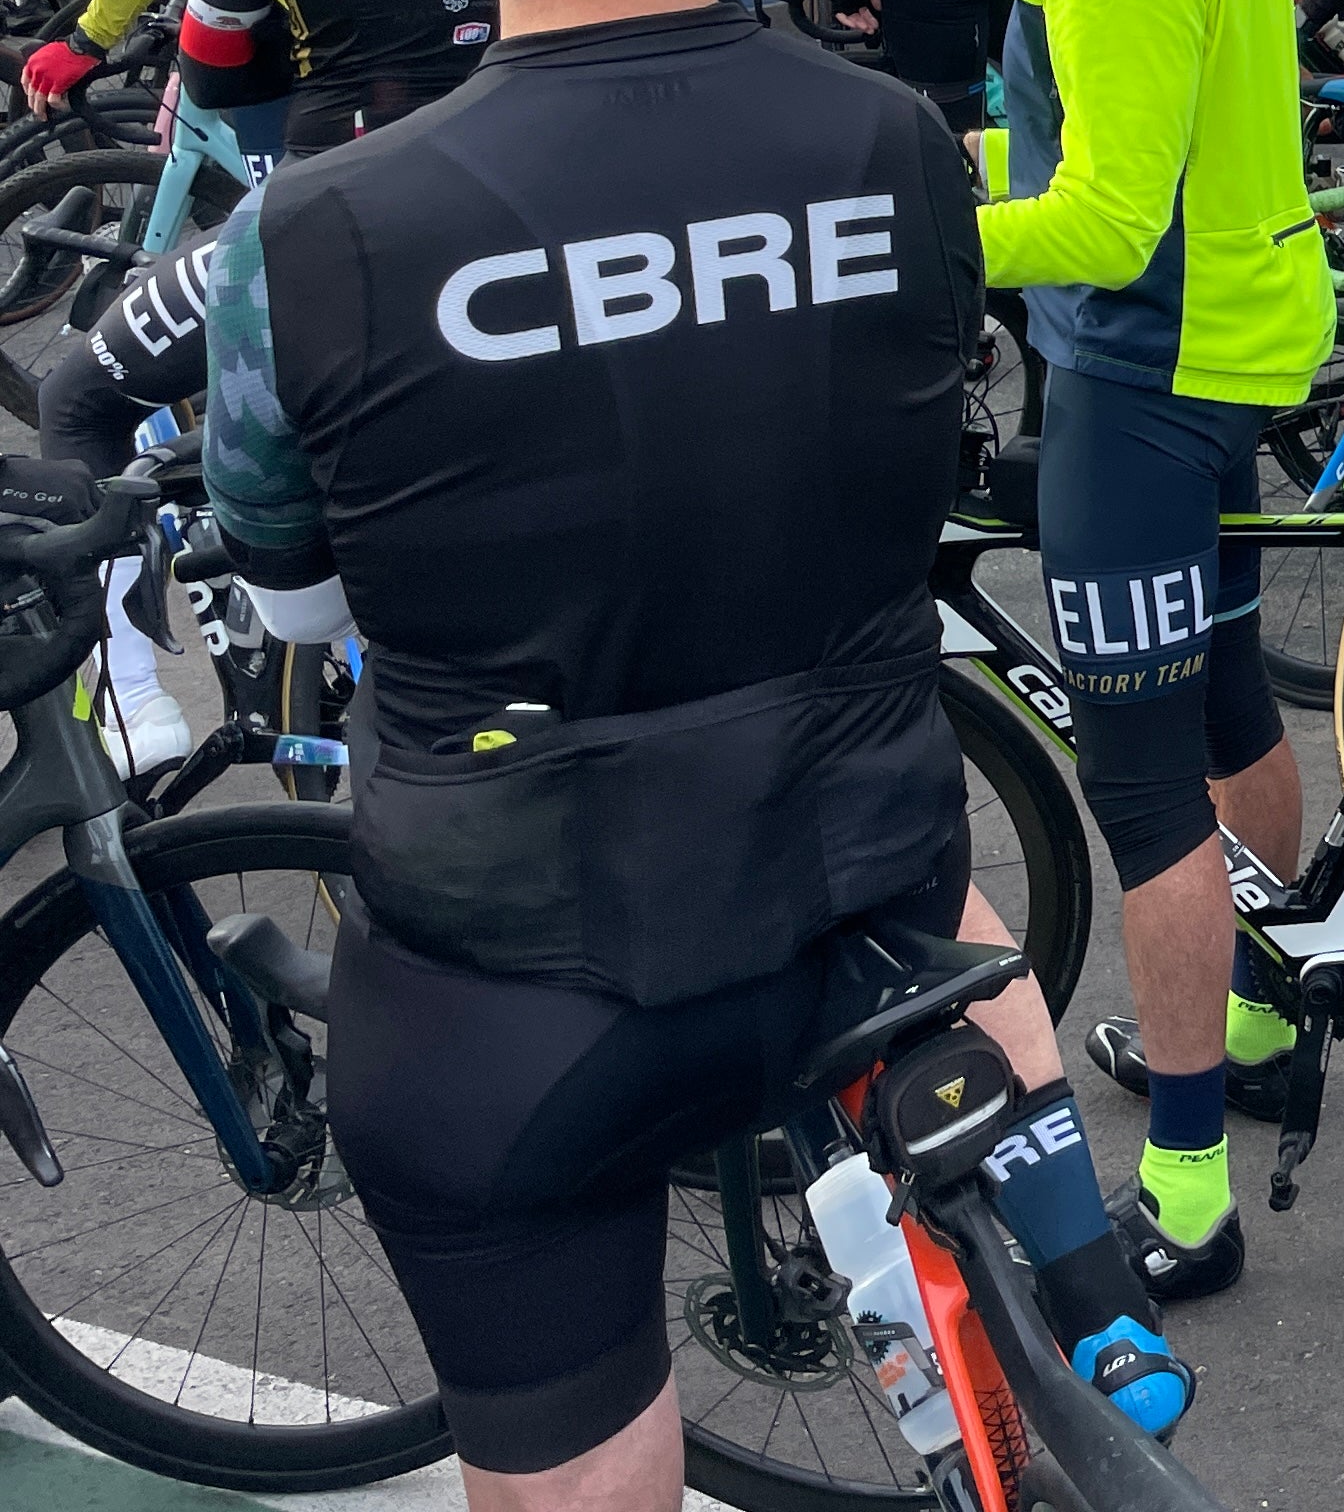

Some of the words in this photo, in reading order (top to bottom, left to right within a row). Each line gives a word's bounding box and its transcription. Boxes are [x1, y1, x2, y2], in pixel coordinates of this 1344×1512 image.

[437, 193, 899, 362] CBRE
[90, 330, 129, 381] 100%
[1051, 564, 1213, 655] ELIEL
[1062, 665, 1147, 694] FACTORY
[1156, 652, 1205, 686] TEAM
[985, 1107, 1082, 1182] RE
